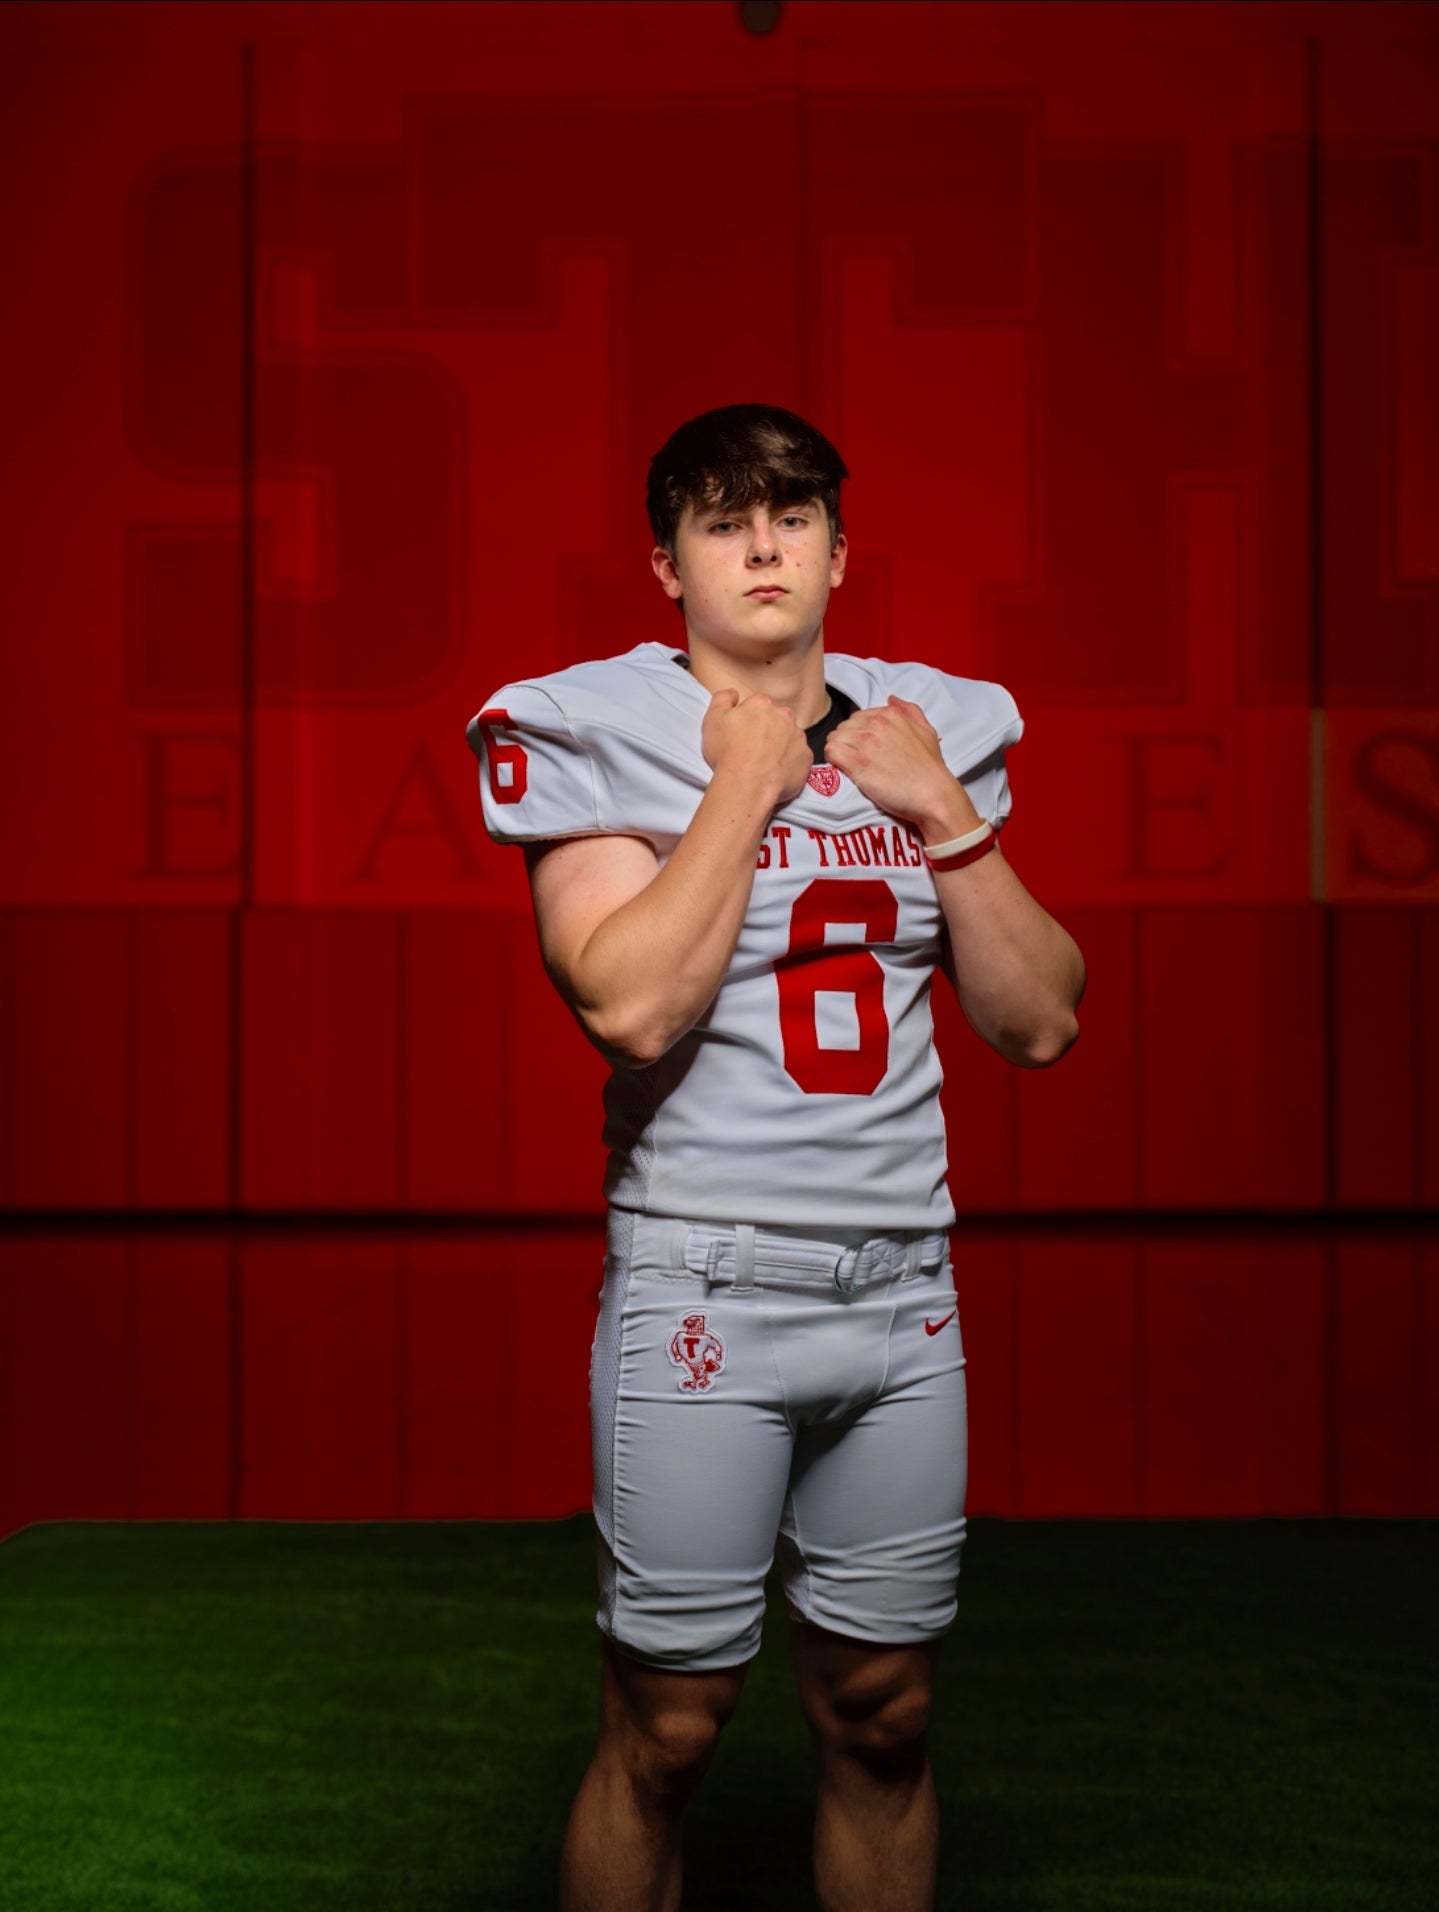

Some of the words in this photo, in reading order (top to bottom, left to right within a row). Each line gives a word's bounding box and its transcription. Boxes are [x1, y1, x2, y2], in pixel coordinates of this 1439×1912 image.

[477, 709, 528, 805] 6
[122, 728, 1439, 884] EAES
[808, 826, 922, 867] THOMAS
[774, 878, 899, 1096] 6
[683, 1338, 700, 1358] T
